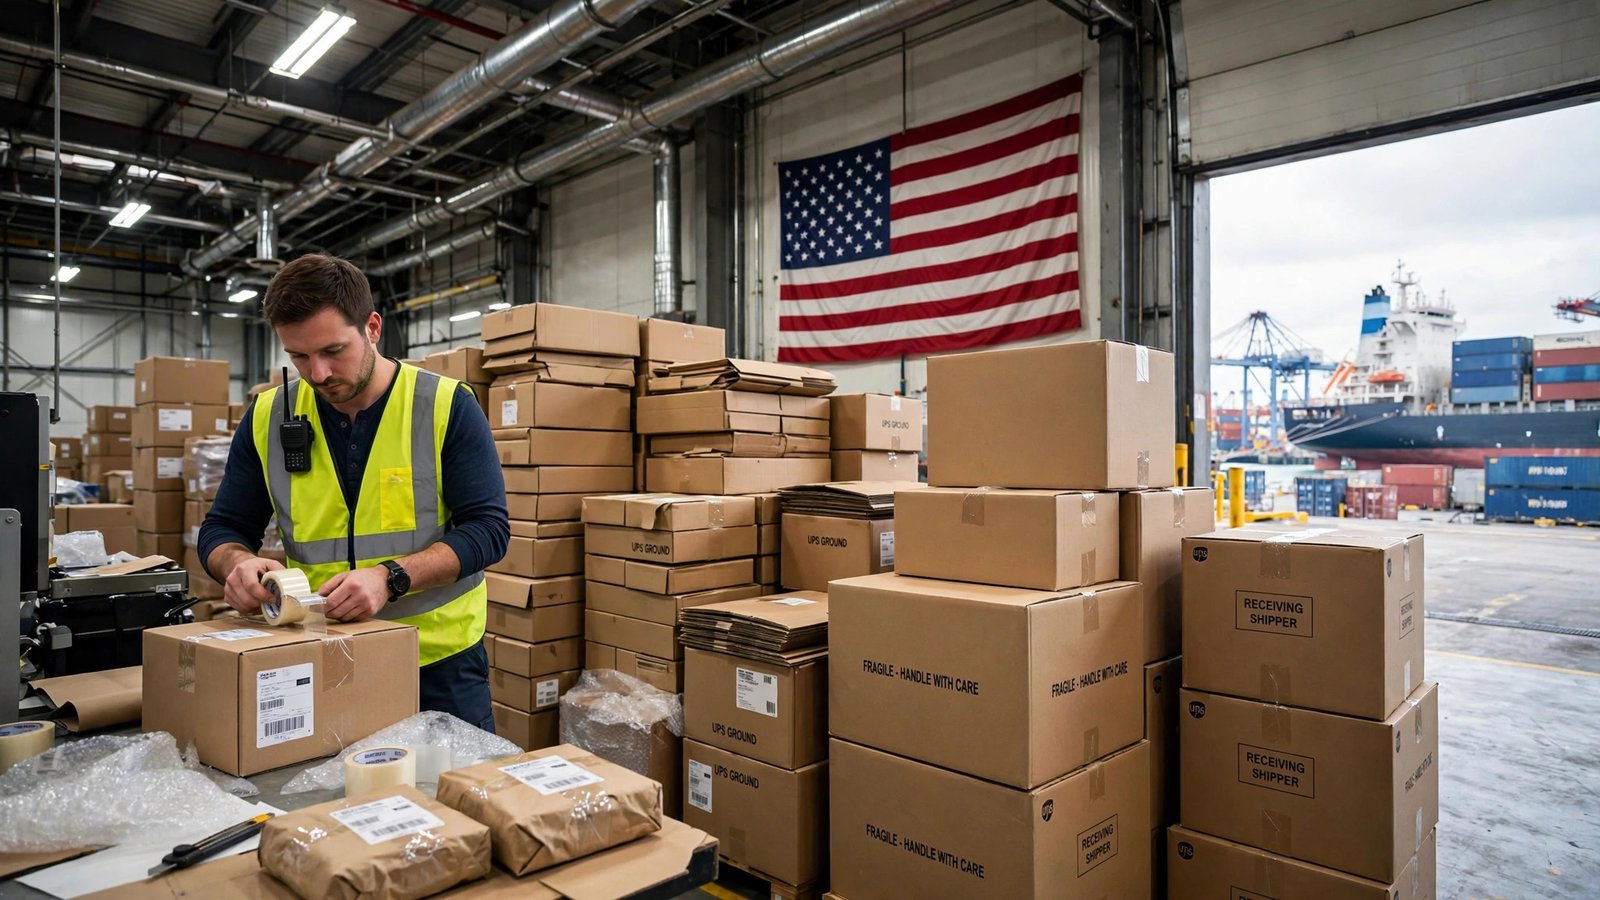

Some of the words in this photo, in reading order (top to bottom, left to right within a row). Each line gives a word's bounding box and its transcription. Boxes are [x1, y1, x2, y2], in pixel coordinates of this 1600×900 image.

[631, 542, 643, 552] UPS
[644, 543, 670, 555] GROUND
[808, 535, 820, 545] UPS
[820, 536, 848, 548] GROUND
[1244, 598, 1304, 614] RECEIVING
[1250, 613, 1298, 628] SHIPPER
[863, 660, 894, 677] FRAGILE
[900, 667, 931, 685] HANDLE
[933, 673, 954, 690] WITH
[955, 678, 979, 695] CARE
[1051, 678, 1075, 698] FRAGILE
[1080, 669, 1101, 688] HANDLE
[1114, 660, 1128, 677] CARE
[712, 722, 725, 736] UPS
[727, 727, 757, 745] GROUND
[1246, 752, 1305, 774] RECEIVING
[714, 764, 728, 778] UPS
[729, 770, 759, 789] GROUND
[1252, 768, 1299, 788] SHIPPER
[1082, 823, 1114, 851] RECEIVING
[866, 824, 898, 847] FRAGILE
[904, 838, 936, 860] HANDLE
[937, 849, 959, 869] WITH
[960, 858, 985, 879] CARE
[1086, 841, 1111, 864] SHIPPER
